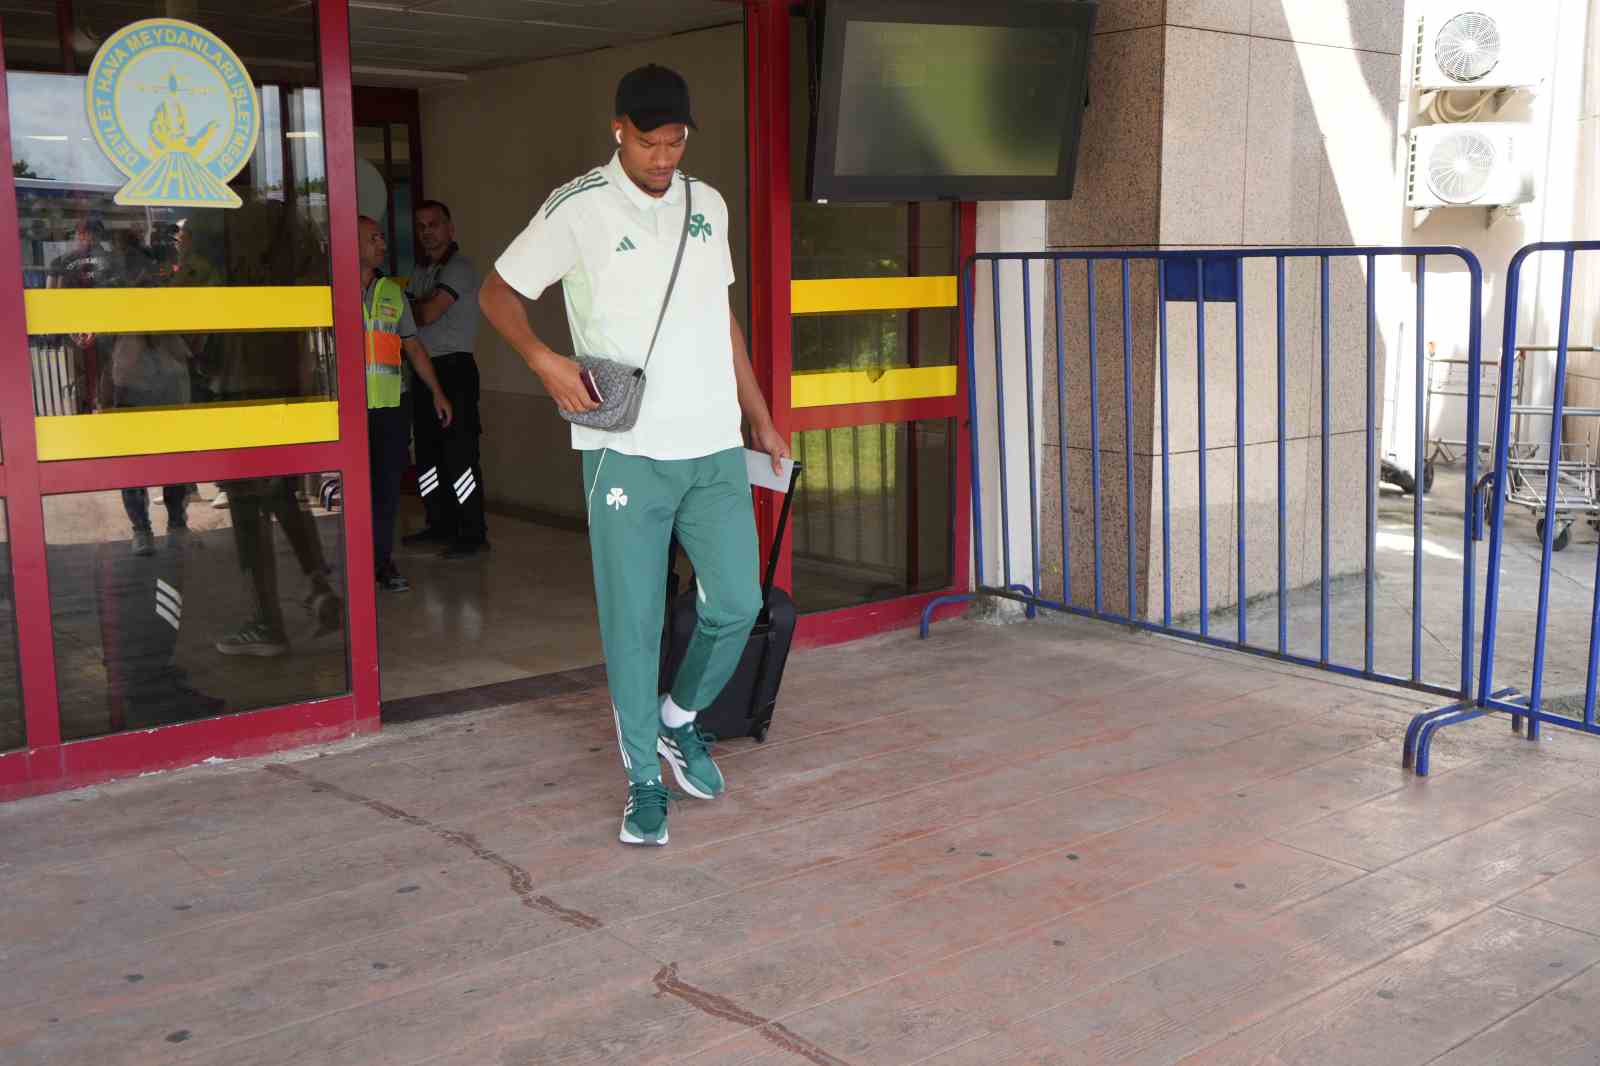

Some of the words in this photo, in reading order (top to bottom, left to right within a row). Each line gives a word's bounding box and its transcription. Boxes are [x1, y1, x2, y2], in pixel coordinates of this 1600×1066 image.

[97, 47, 128, 91] HAVA
[126, 28, 238, 80] MEYDANLARI
[96, 97, 139, 168] DEVLET
